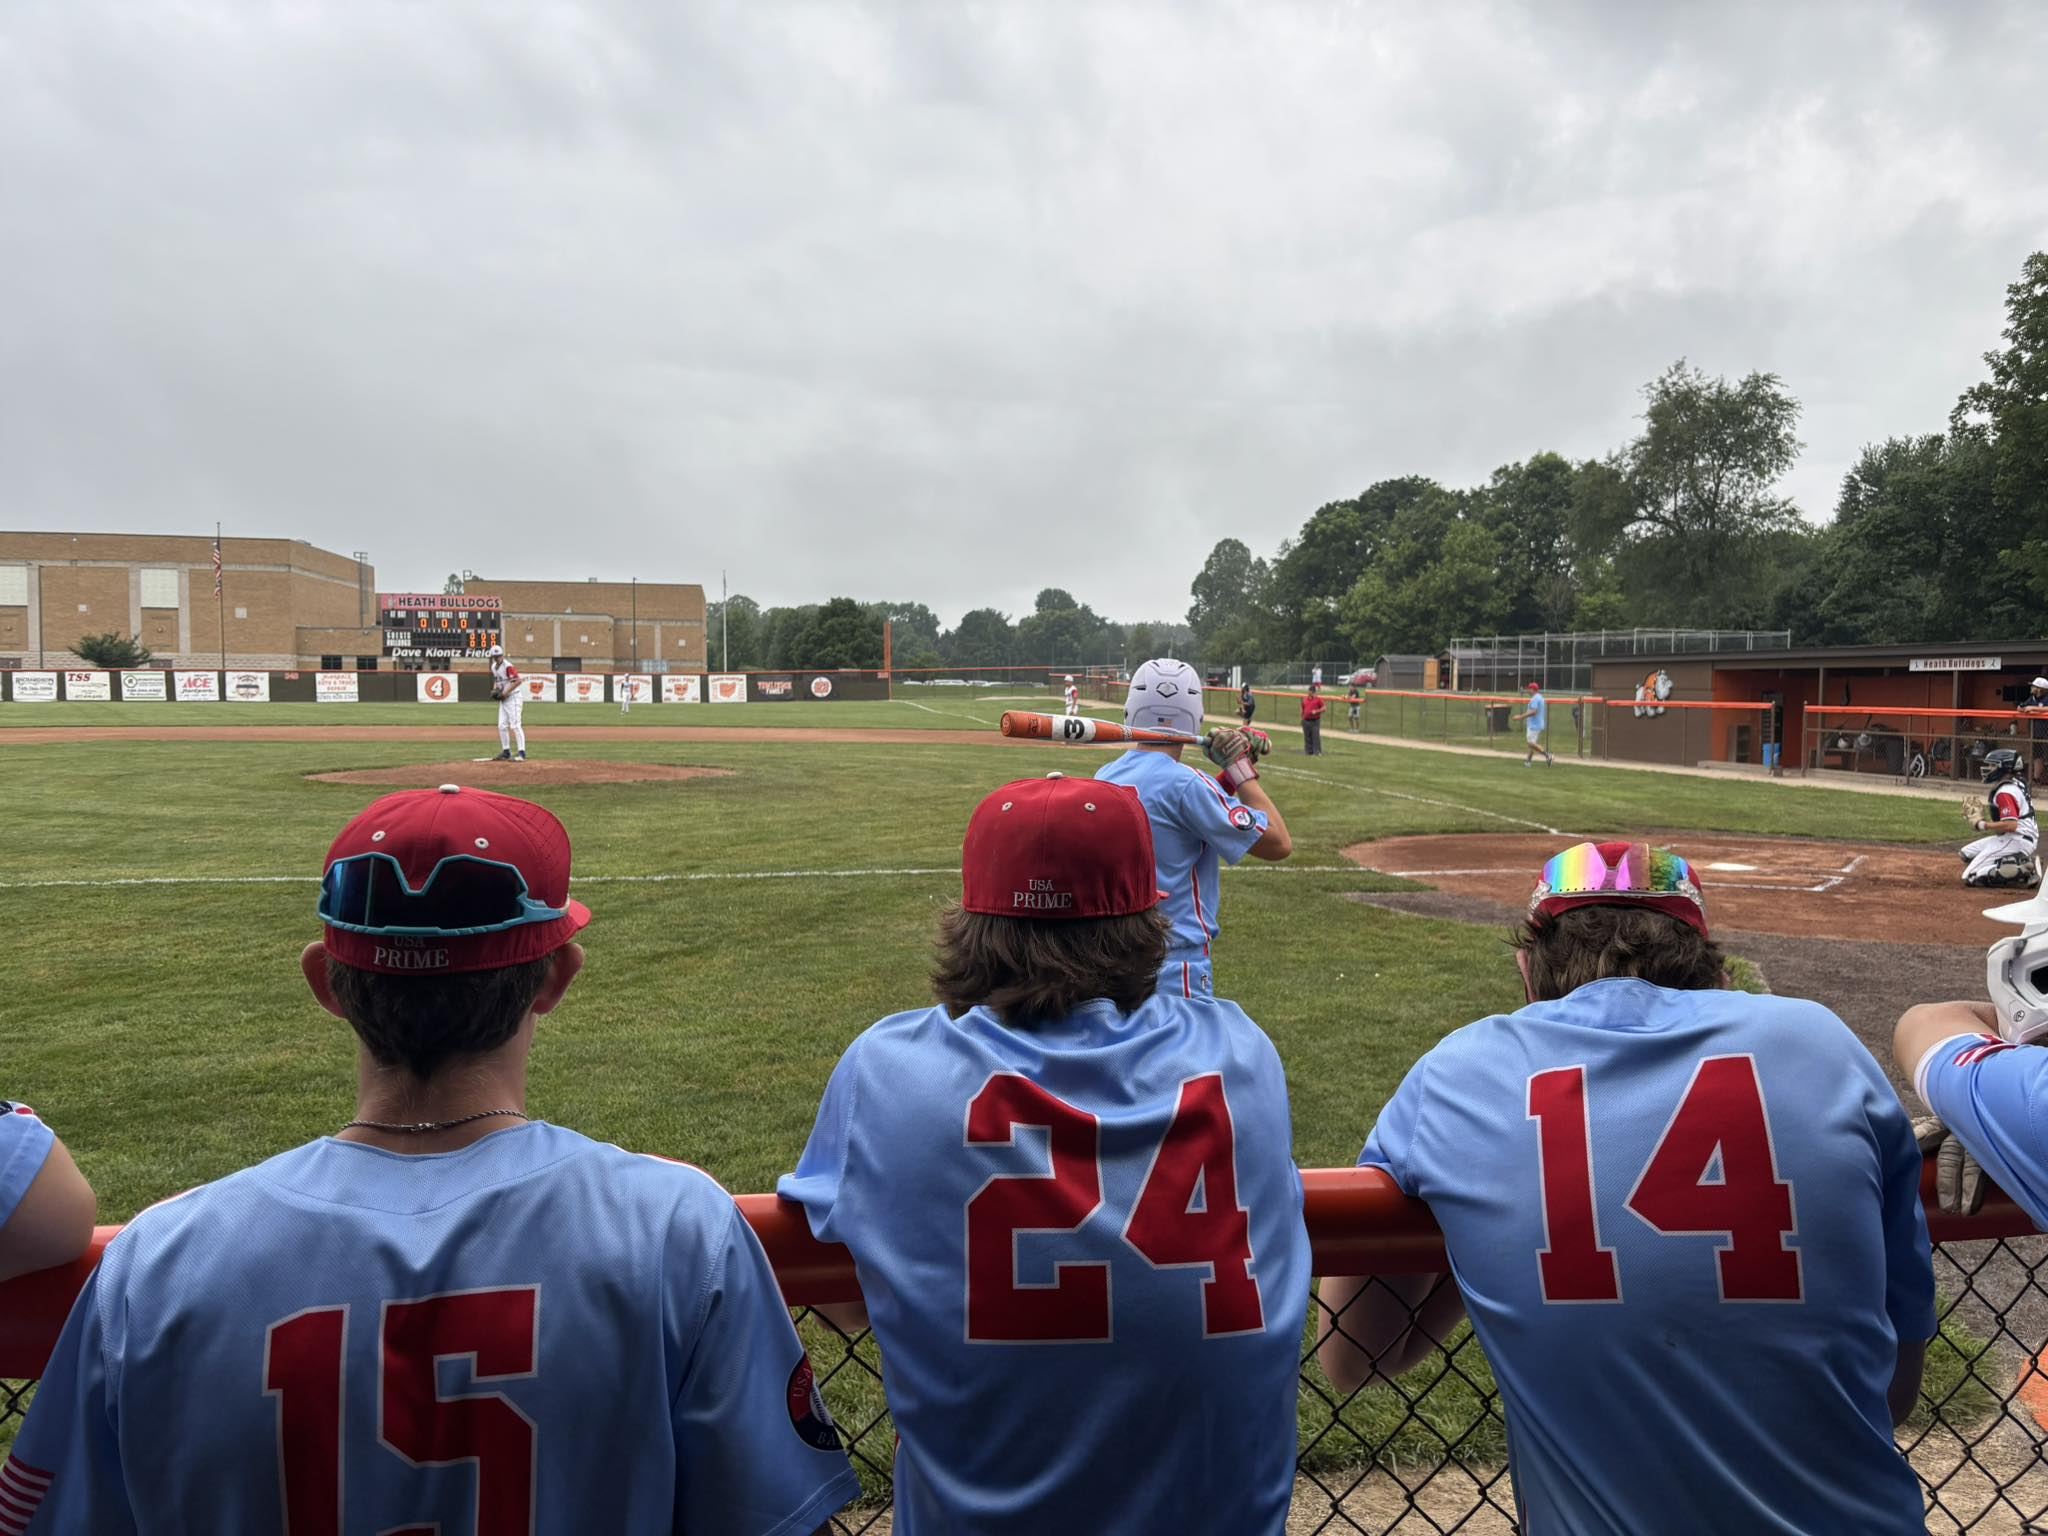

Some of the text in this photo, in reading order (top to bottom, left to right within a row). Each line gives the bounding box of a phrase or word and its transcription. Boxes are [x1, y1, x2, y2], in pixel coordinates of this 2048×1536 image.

[399, 597, 500, 608] HEATH BULLDOGS
[420, 618, 428, 628] 0
[441, 618, 448, 628] 0
[460, 618, 468, 628] 0
[469, 632, 476, 640] 0
[481, 632, 487, 640] 0
[469, 640, 476, 648] 0
[481, 640, 487, 648] 0
[392, 648, 492, 657] Dave Klontz Field
[1923, 659, 1986, 669] Heath Bulldogs
[67, 673, 92, 682] TSS
[183, 677, 212, 688] ACE
[430, 679, 444, 697] 4
[1064, 719, 1085, 739] 3
[1029, 879, 1055, 891] USA
[1012, 891, 1072, 909] PRIME
[394, 935, 425, 948] USA
[373, 945, 449, 969] PRIME
[1526, 1053, 1805, 1304] 14
[963, 1070, 1266, 1344] 24
[262, 1283, 541, 1536] 15
